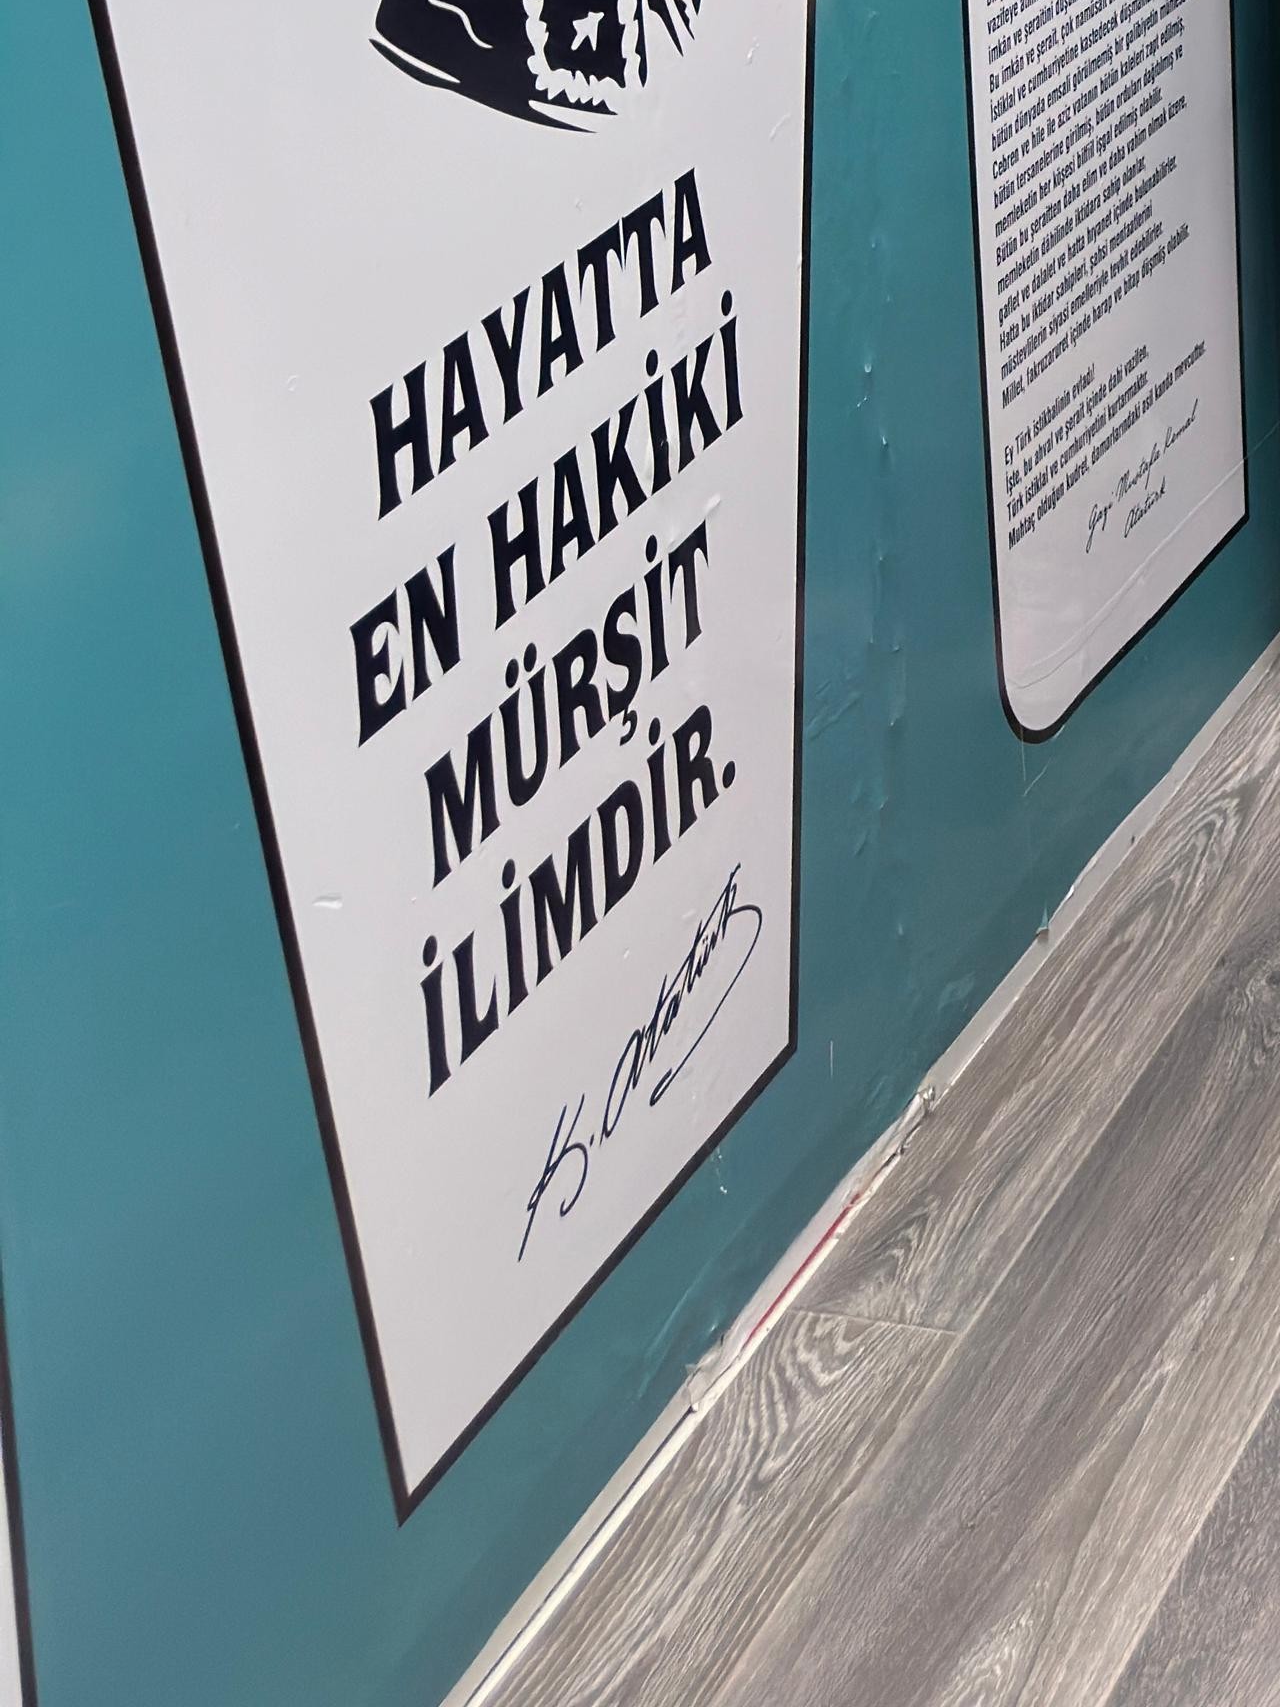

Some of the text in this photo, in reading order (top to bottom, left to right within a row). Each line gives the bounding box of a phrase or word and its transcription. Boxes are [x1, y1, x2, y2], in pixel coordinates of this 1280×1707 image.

[987, 2, 1018, 34] vazifeye
[988, 35, 1011, 64] imkân
[1013, 28, 1023, 46] ve
[1024, 1, 1054, 44] şeraitini
[989, 73, 1000, 93] Bu
[1001, 55, 1024, 84] imkân
[1025, 48, 1035, 66] ve
[1061, 16, 1074, 44] çok
[990, 87, 1016, 122] İstiklal
[1017, 83, 1027, 102] ve
[991, 123, 1013, 151] bütün
[1014, 97, 1045, 134] dünyada
[1047, 74, 1071, 108] emsali
[992, 148, 1019, 179] Cebren
[1020, 139, 1030, 157] ve
[1031, 126, 1045, 149] hile
[1046, 117, 1056, 137] ile
[1057, 105, 1071, 128] aziz
[993, 180, 1015, 209] bütün
[1039, 179, 1051, 201] her
[1053, 155, 1076, 189] köşesi
[996, 237, 1018, 266] Bütün
[1019, 228, 1029, 247] bu
[1030, 200, 1062, 242] şeraitten
[1063, 183, 1081, 209] daha
[1041, 217, 1073, 256] dâhilinde
[998, 291, 1020, 327] gaflet
[1021, 284, 1031, 303] ve
[1031, 258, 1056, 294] dalalet
[1057, 252, 1066, 270] ve
[1067, 235, 1085, 261] hatta
[369, 167, 712, 521] HAYATTA
[999, 323, 1020, 352] Hatta
[1021, 313, 1031, 332] bu
[1032, 291, 1054, 322] iktidar
[1048, 302, 1069, 336] siyasi
[1004, 445, 1014, 466] Ey
[1015, 426, 1032, 454] Türk
[1023, 457, 1033, 477] bu
[1034, 432, 1054, 466] ahval
[1054, 426, 1064, 444] ve
[1065, 402, 1085, 441] şerait
[349, 289, 743, 747] EN HAKİKİ
[1007, 493, 1024, 521] Türk
[1025, 466, 1049, 504] istiklal
[1049, 460, 1059, 479] ve
[1008, 512, 1035, 549] Muhtaç
[1037, 482, 1065, 520] olduğun
[425, 518, 709, 888] MÜRŞİT
[420, 704, 736, 1098] İLİMDİR.
